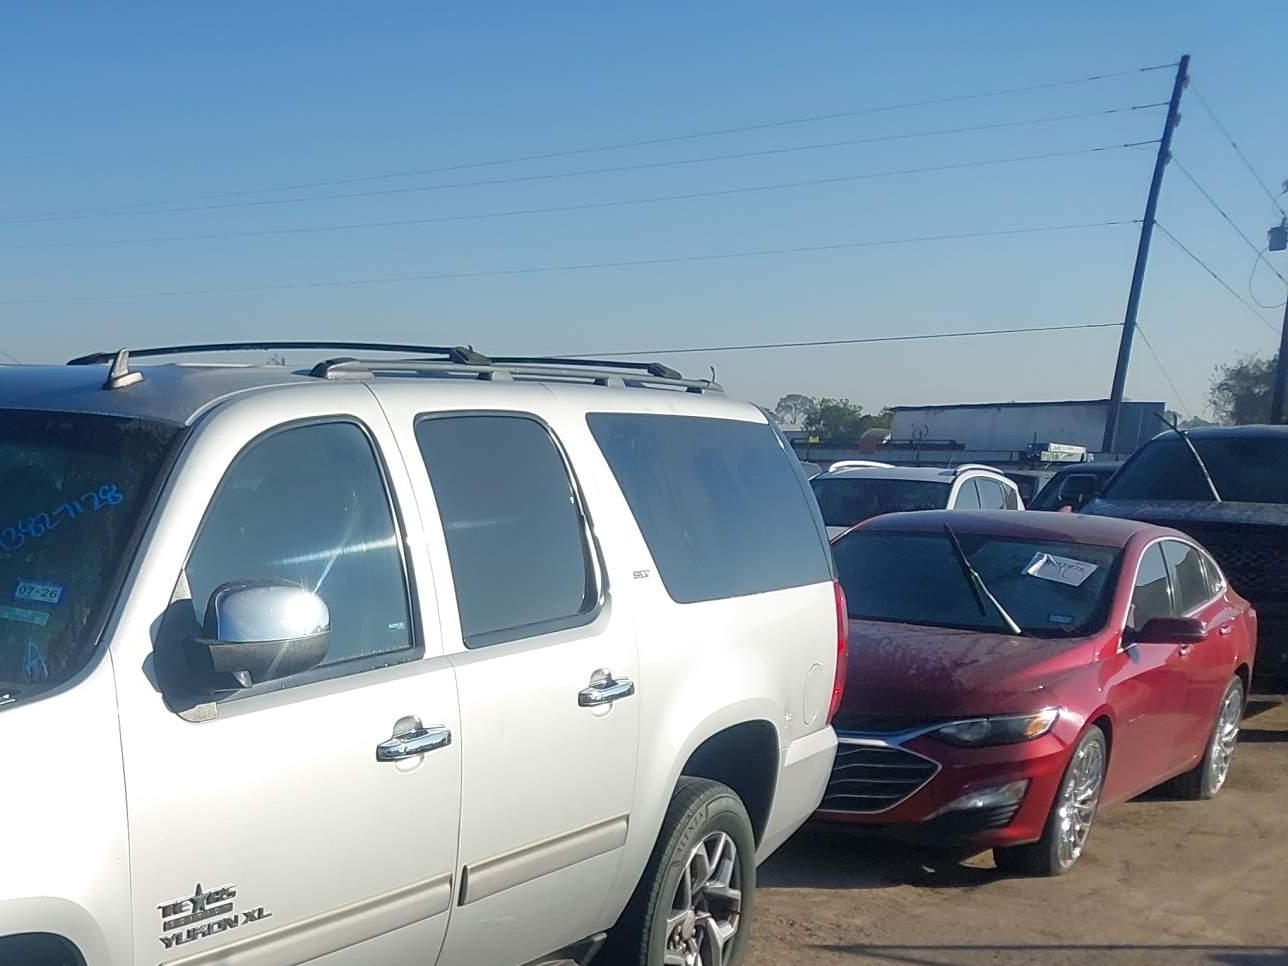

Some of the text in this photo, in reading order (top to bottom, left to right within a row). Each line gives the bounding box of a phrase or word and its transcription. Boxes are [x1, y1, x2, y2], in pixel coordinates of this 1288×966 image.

[18, 585, 58, 599] 07-26
[25, 641, 48, 678] A
[159, 915, 239, 949] YUKON
[241, 906, 273, 926] XL
